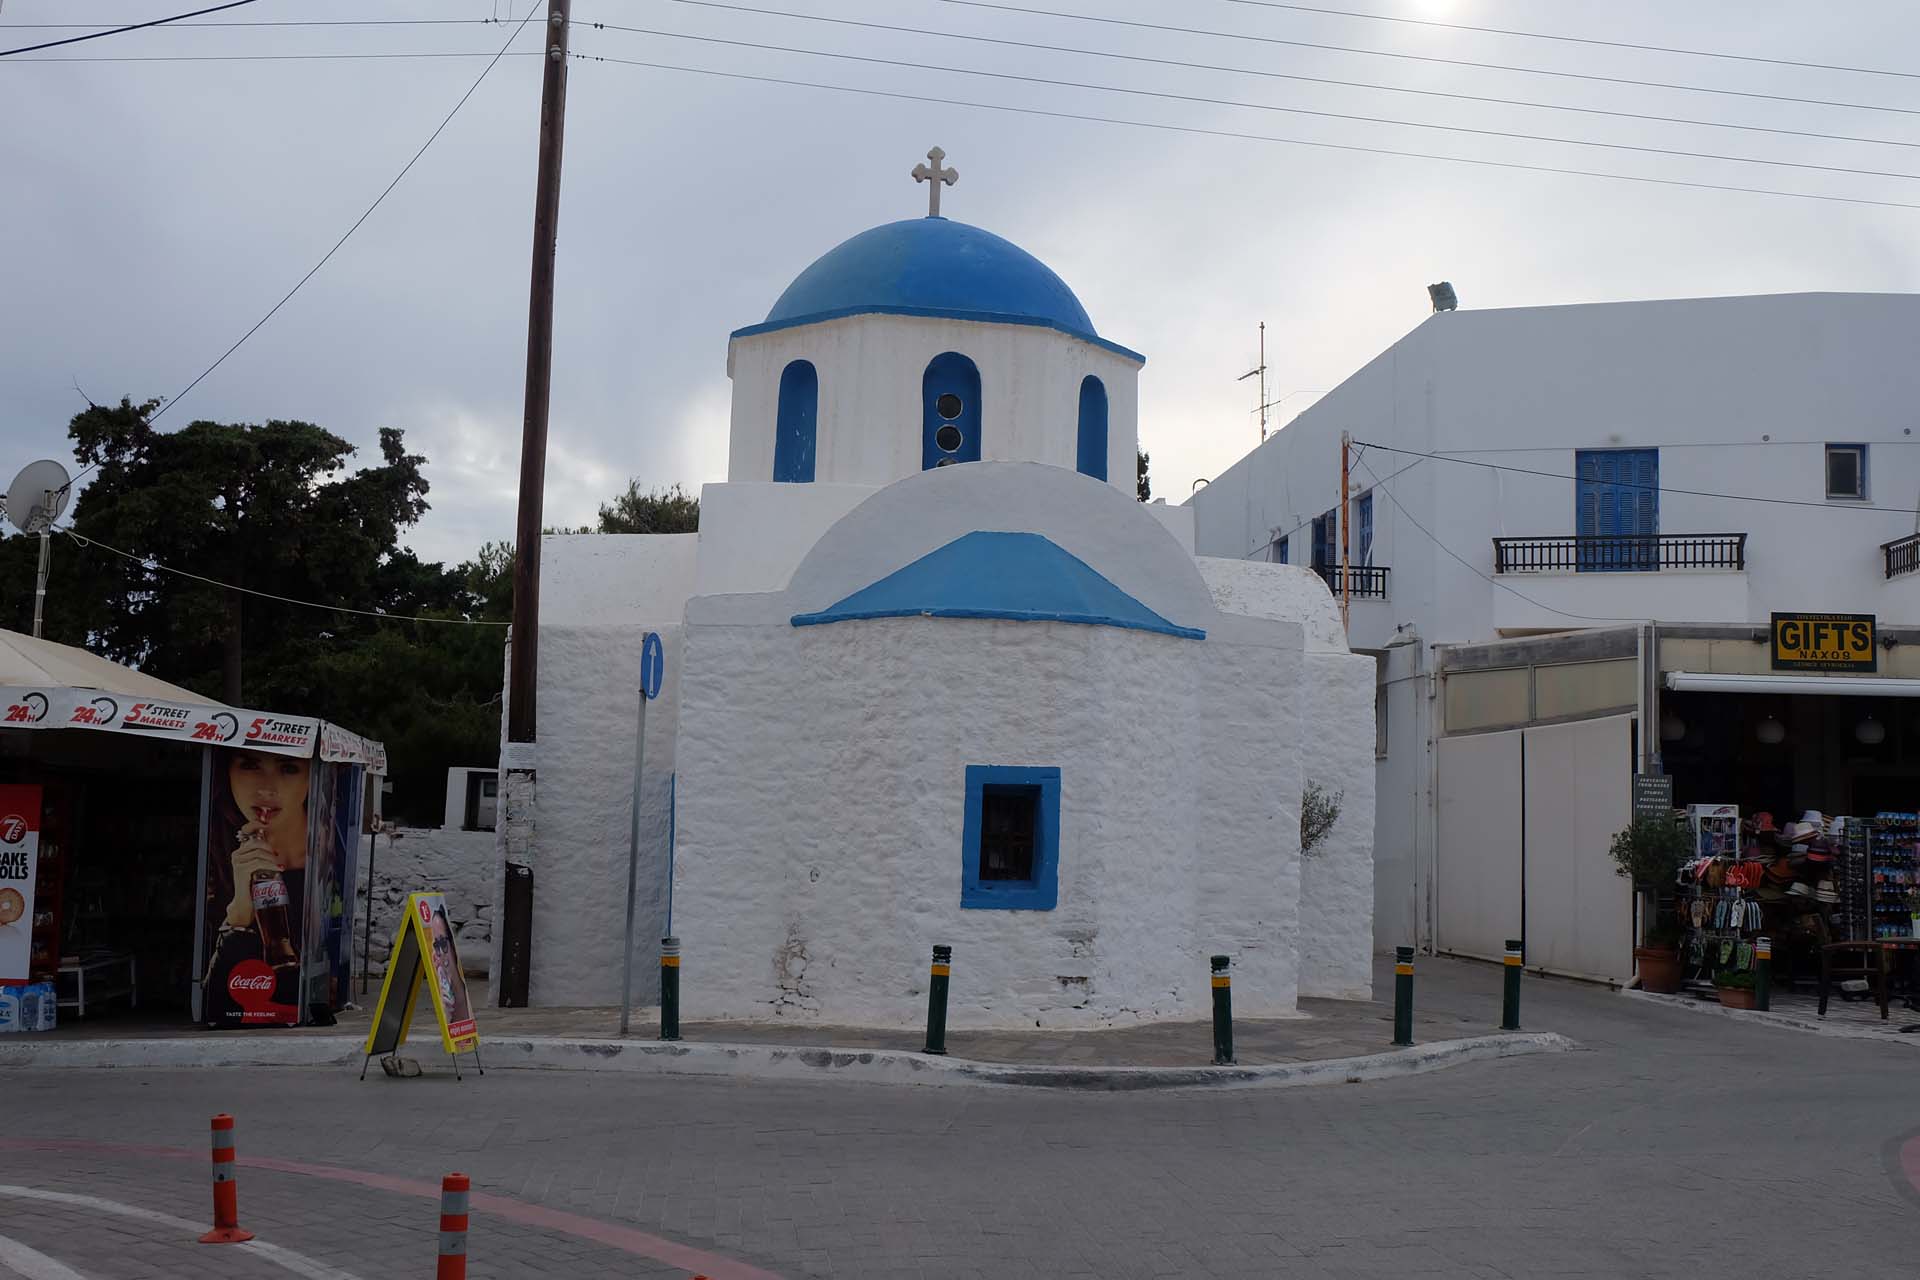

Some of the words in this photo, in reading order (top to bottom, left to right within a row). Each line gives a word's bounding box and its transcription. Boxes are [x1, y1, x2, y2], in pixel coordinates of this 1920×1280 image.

[1780, 621, 1869, 651] GIFTS
[4, 704, 35, 722] 24H
[70, 705, 103, 725] 24H
[150, 705, 191, 720] STREET
[139, 715, 187, 729] MARKETS
[271, 720, 311, 735] STREET
[190, 722, 224, 742] 24H
[260, 732, 308, 745] MARKETS
[3, 818, 20, 841] 7
[0, 852, 28, 866] AKE
[0, 865, 29, 880] OLLS
